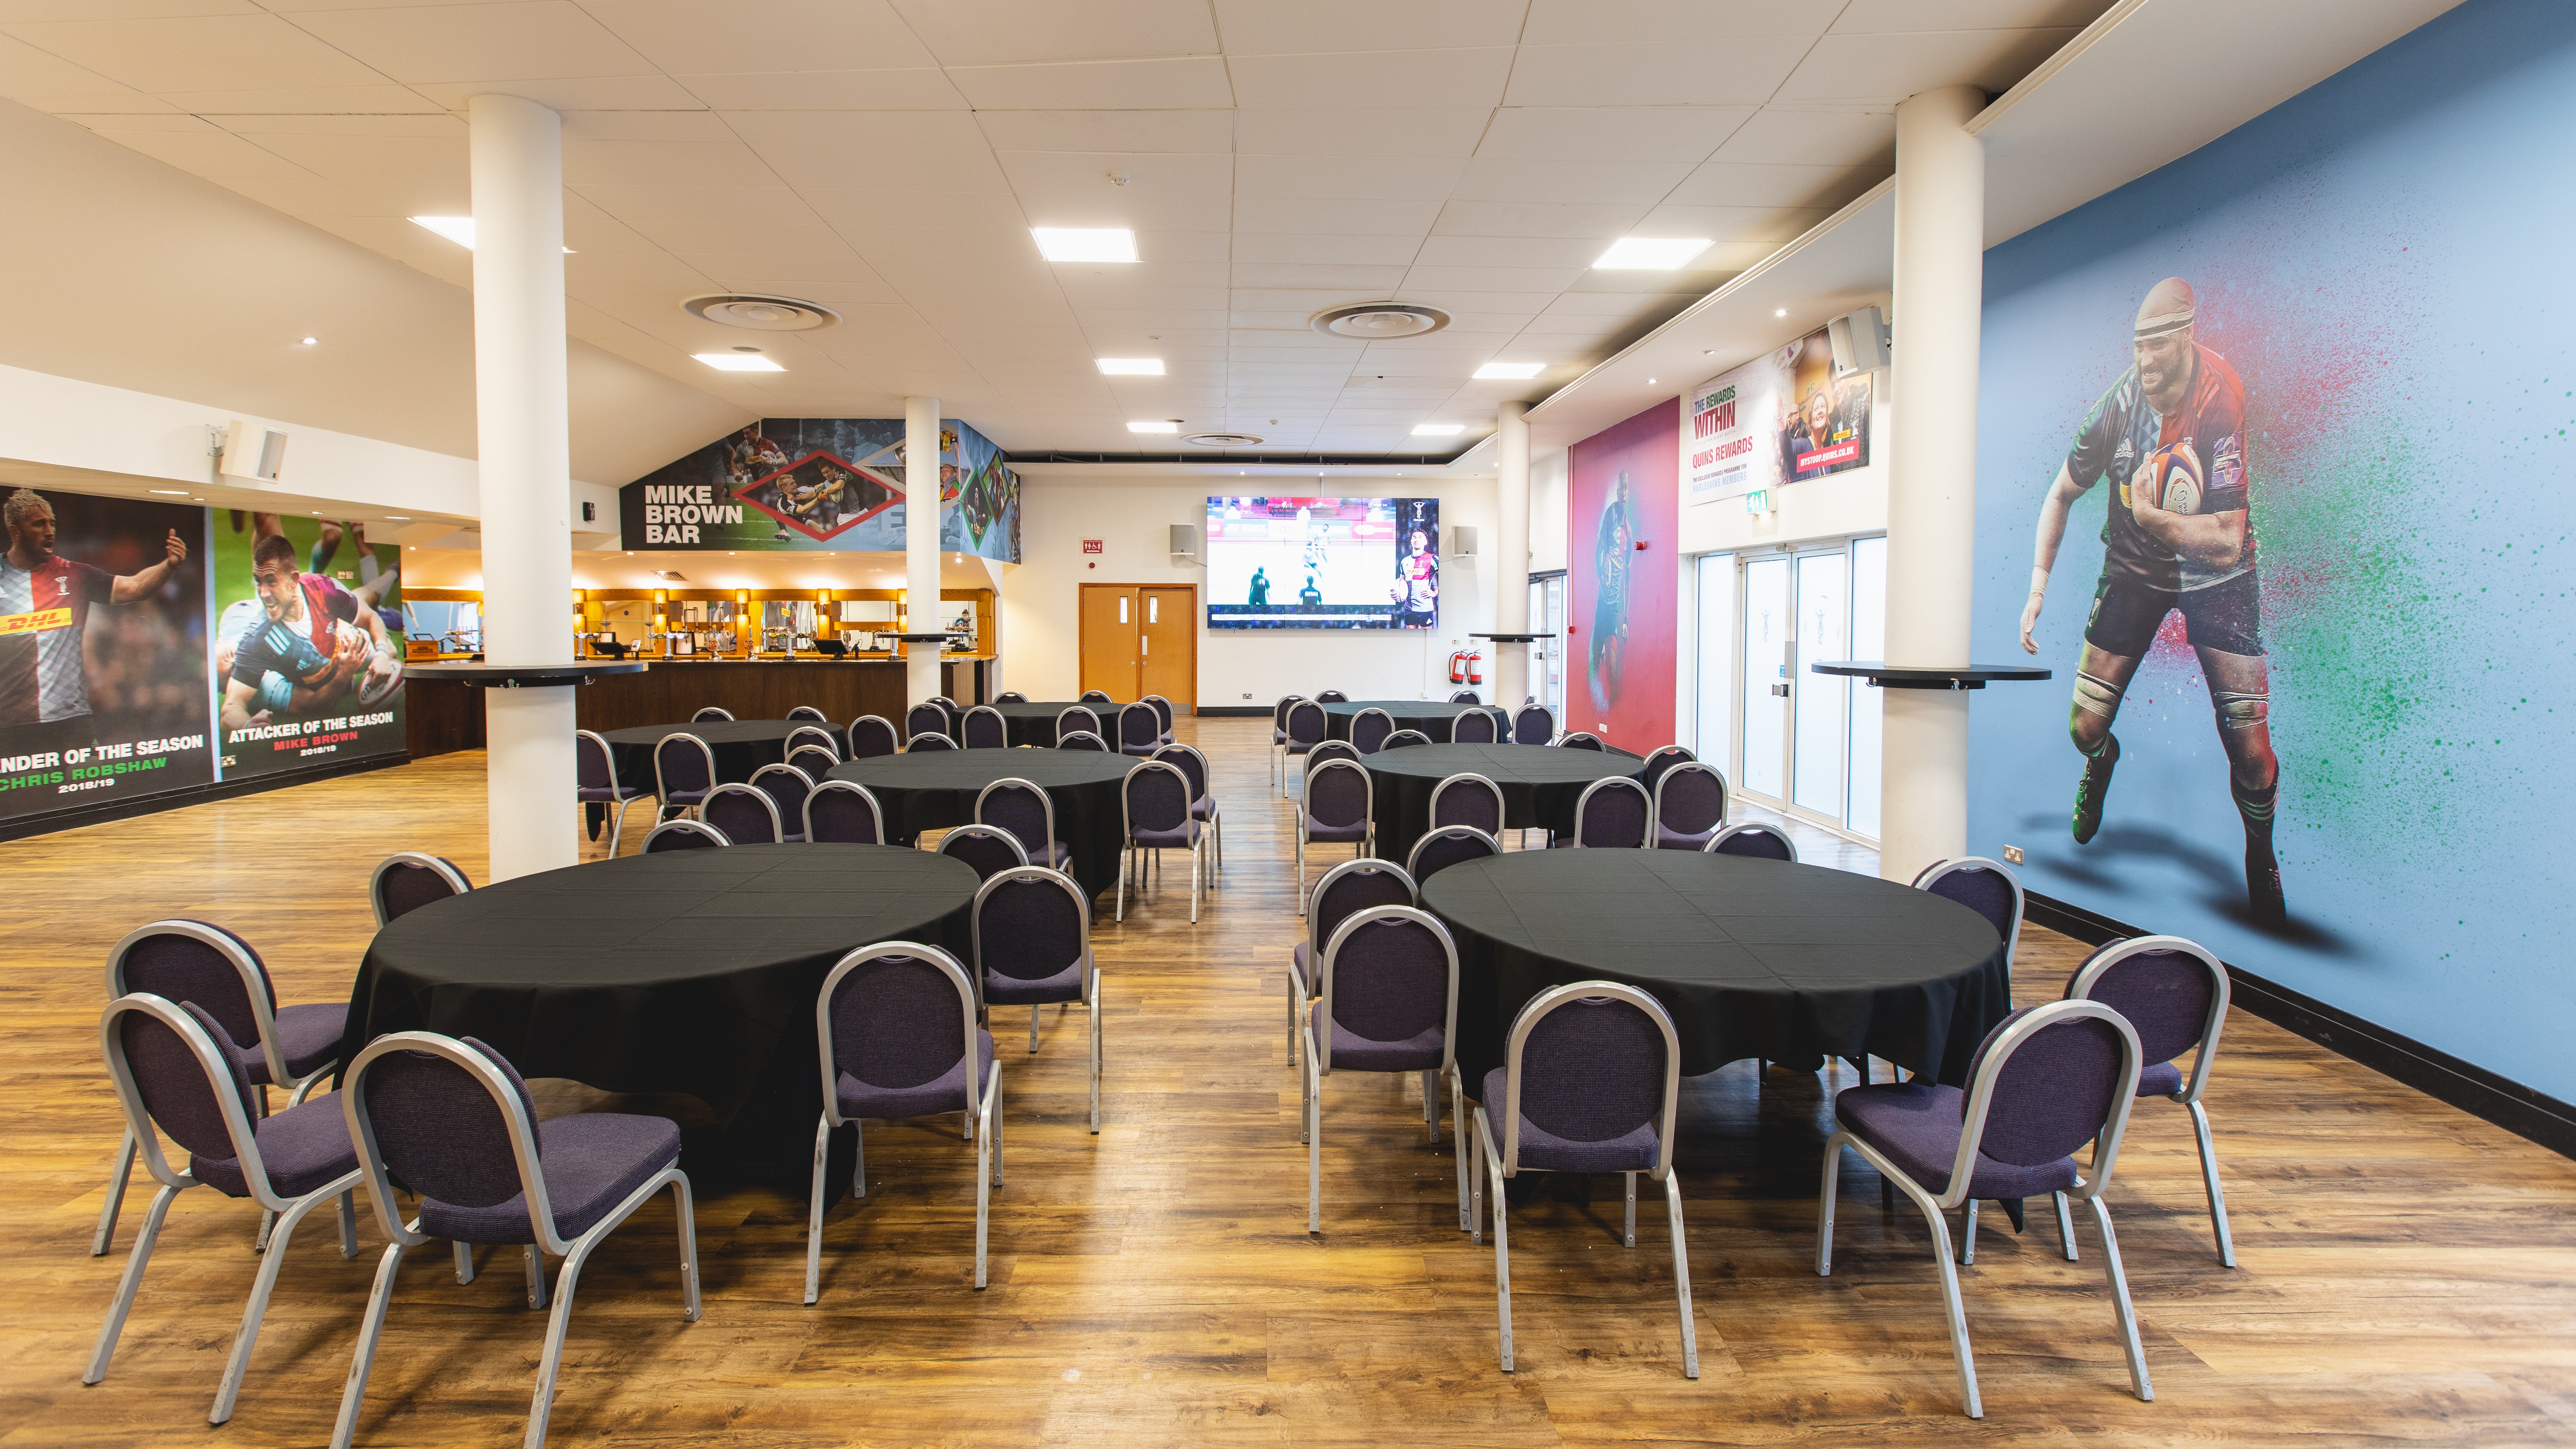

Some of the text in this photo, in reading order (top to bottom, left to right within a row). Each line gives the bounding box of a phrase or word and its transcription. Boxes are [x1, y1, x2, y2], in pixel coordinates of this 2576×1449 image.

[1695, 385, 1735, 414] THE REWARDS
[1694, 400, 1735, 440] WITHIN
[1693, 436, 1753, 469] QUINS REWARDS
[1801, 446, 1854, 467] MYSTOOP.QUINS.CO.UK
[2115, 450, 2134, 458] adidas
[1724, 465, 1741, 474] PROGRAMME
[1693, 471, 1747, 493] HARLEQUINS MEMBERS
[645, 485, 712, 504] MIKE
[646, 505, 743, 524] BROWN
[646, 525, 700, 543] BAR
[7, 613, 61, 630] DHL
[228, 711, 393, 743] ATTACKER OF THE SEASON
[274, 731, 358, 751] MIKE BROWN
[300, 745, 337, 756] 2018/19
[0, 734, 204, 773] NDER OF THE SEASON
[0, 757, 167, 791] CHRIS ROBSHAW
[58, 778, 115, 794] 2018/19
